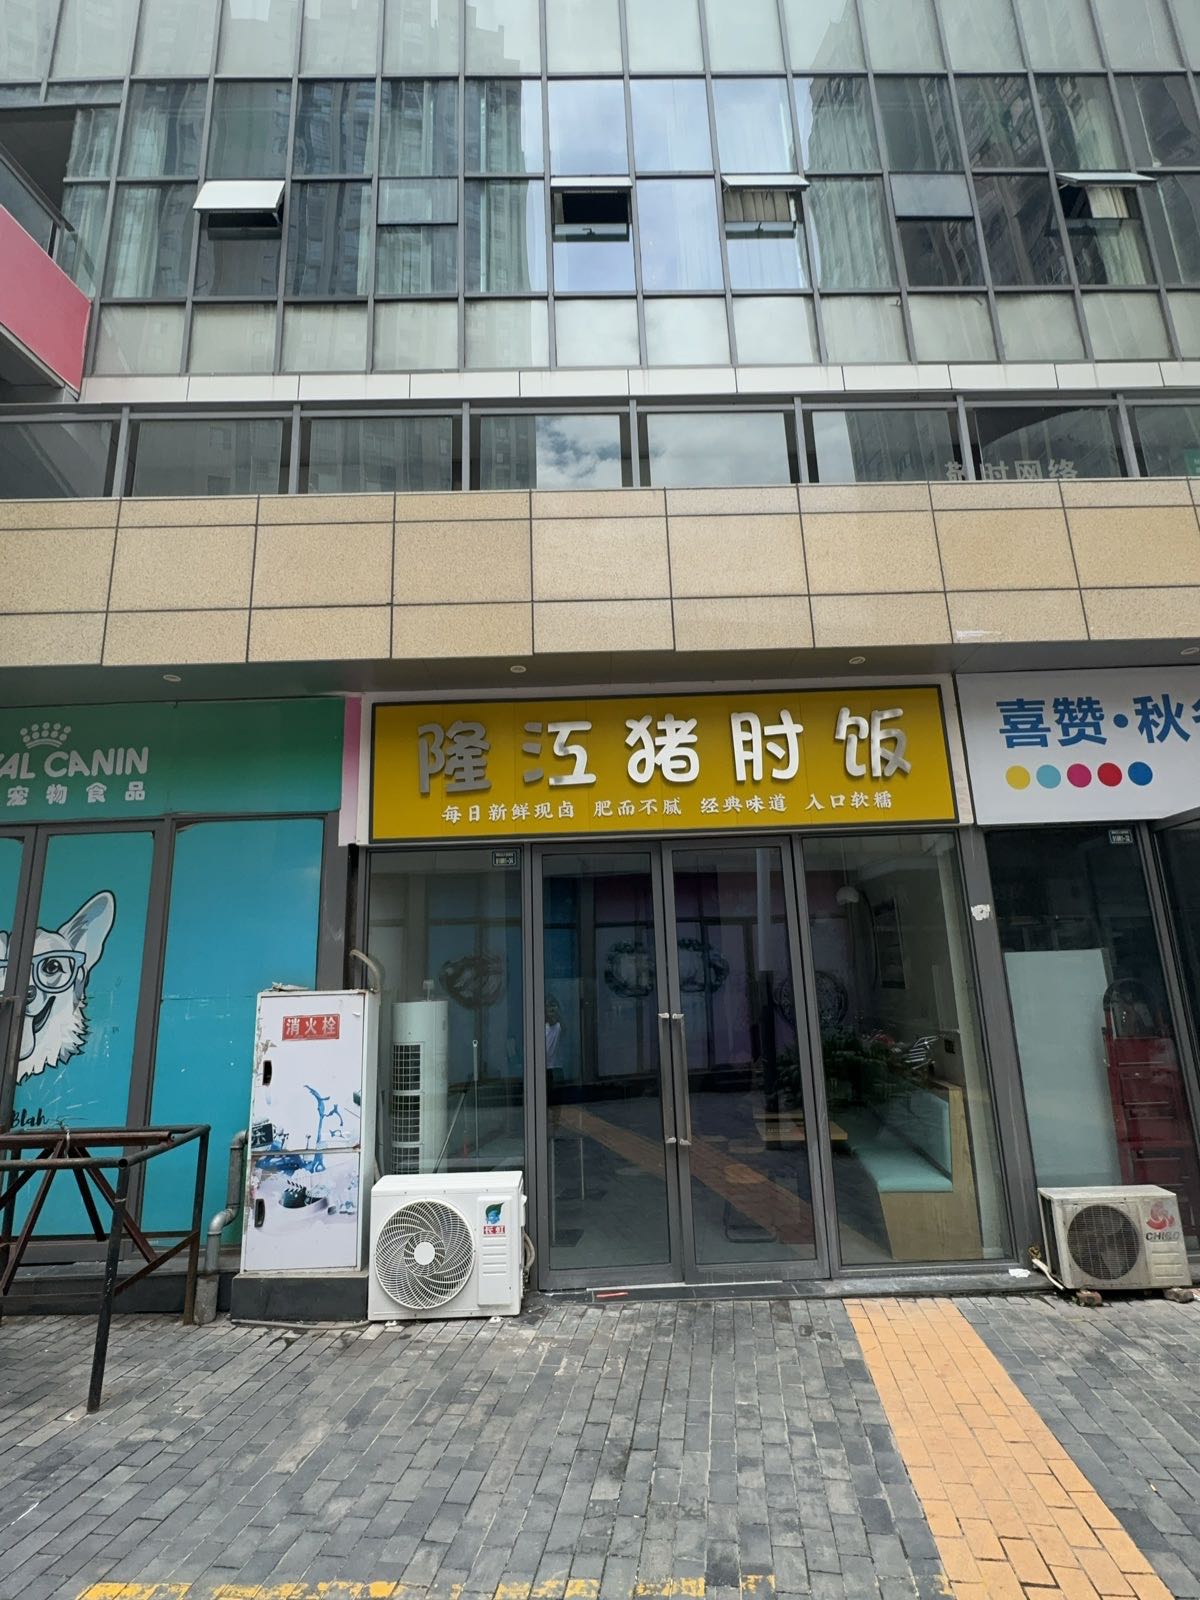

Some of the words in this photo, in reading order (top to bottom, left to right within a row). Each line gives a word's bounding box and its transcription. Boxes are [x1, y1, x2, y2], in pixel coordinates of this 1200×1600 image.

[996, 694, 1200, 748] 喜赞·秋
[44, 747, 148, 778] CANIN
[417, 707, 911, 795] 隆江猪肘饭
[6, 781, 145, 806] 宠物食品
[441, 800, 575, 824] 每日新鲜现卤
[593, 797, 682, 817] 肥而不腻
[700, 794, 788, 814] 经典味道
[805, 791, 892, 810] 入口软糯
[286, 1017, 336, 1036] 消火栓
